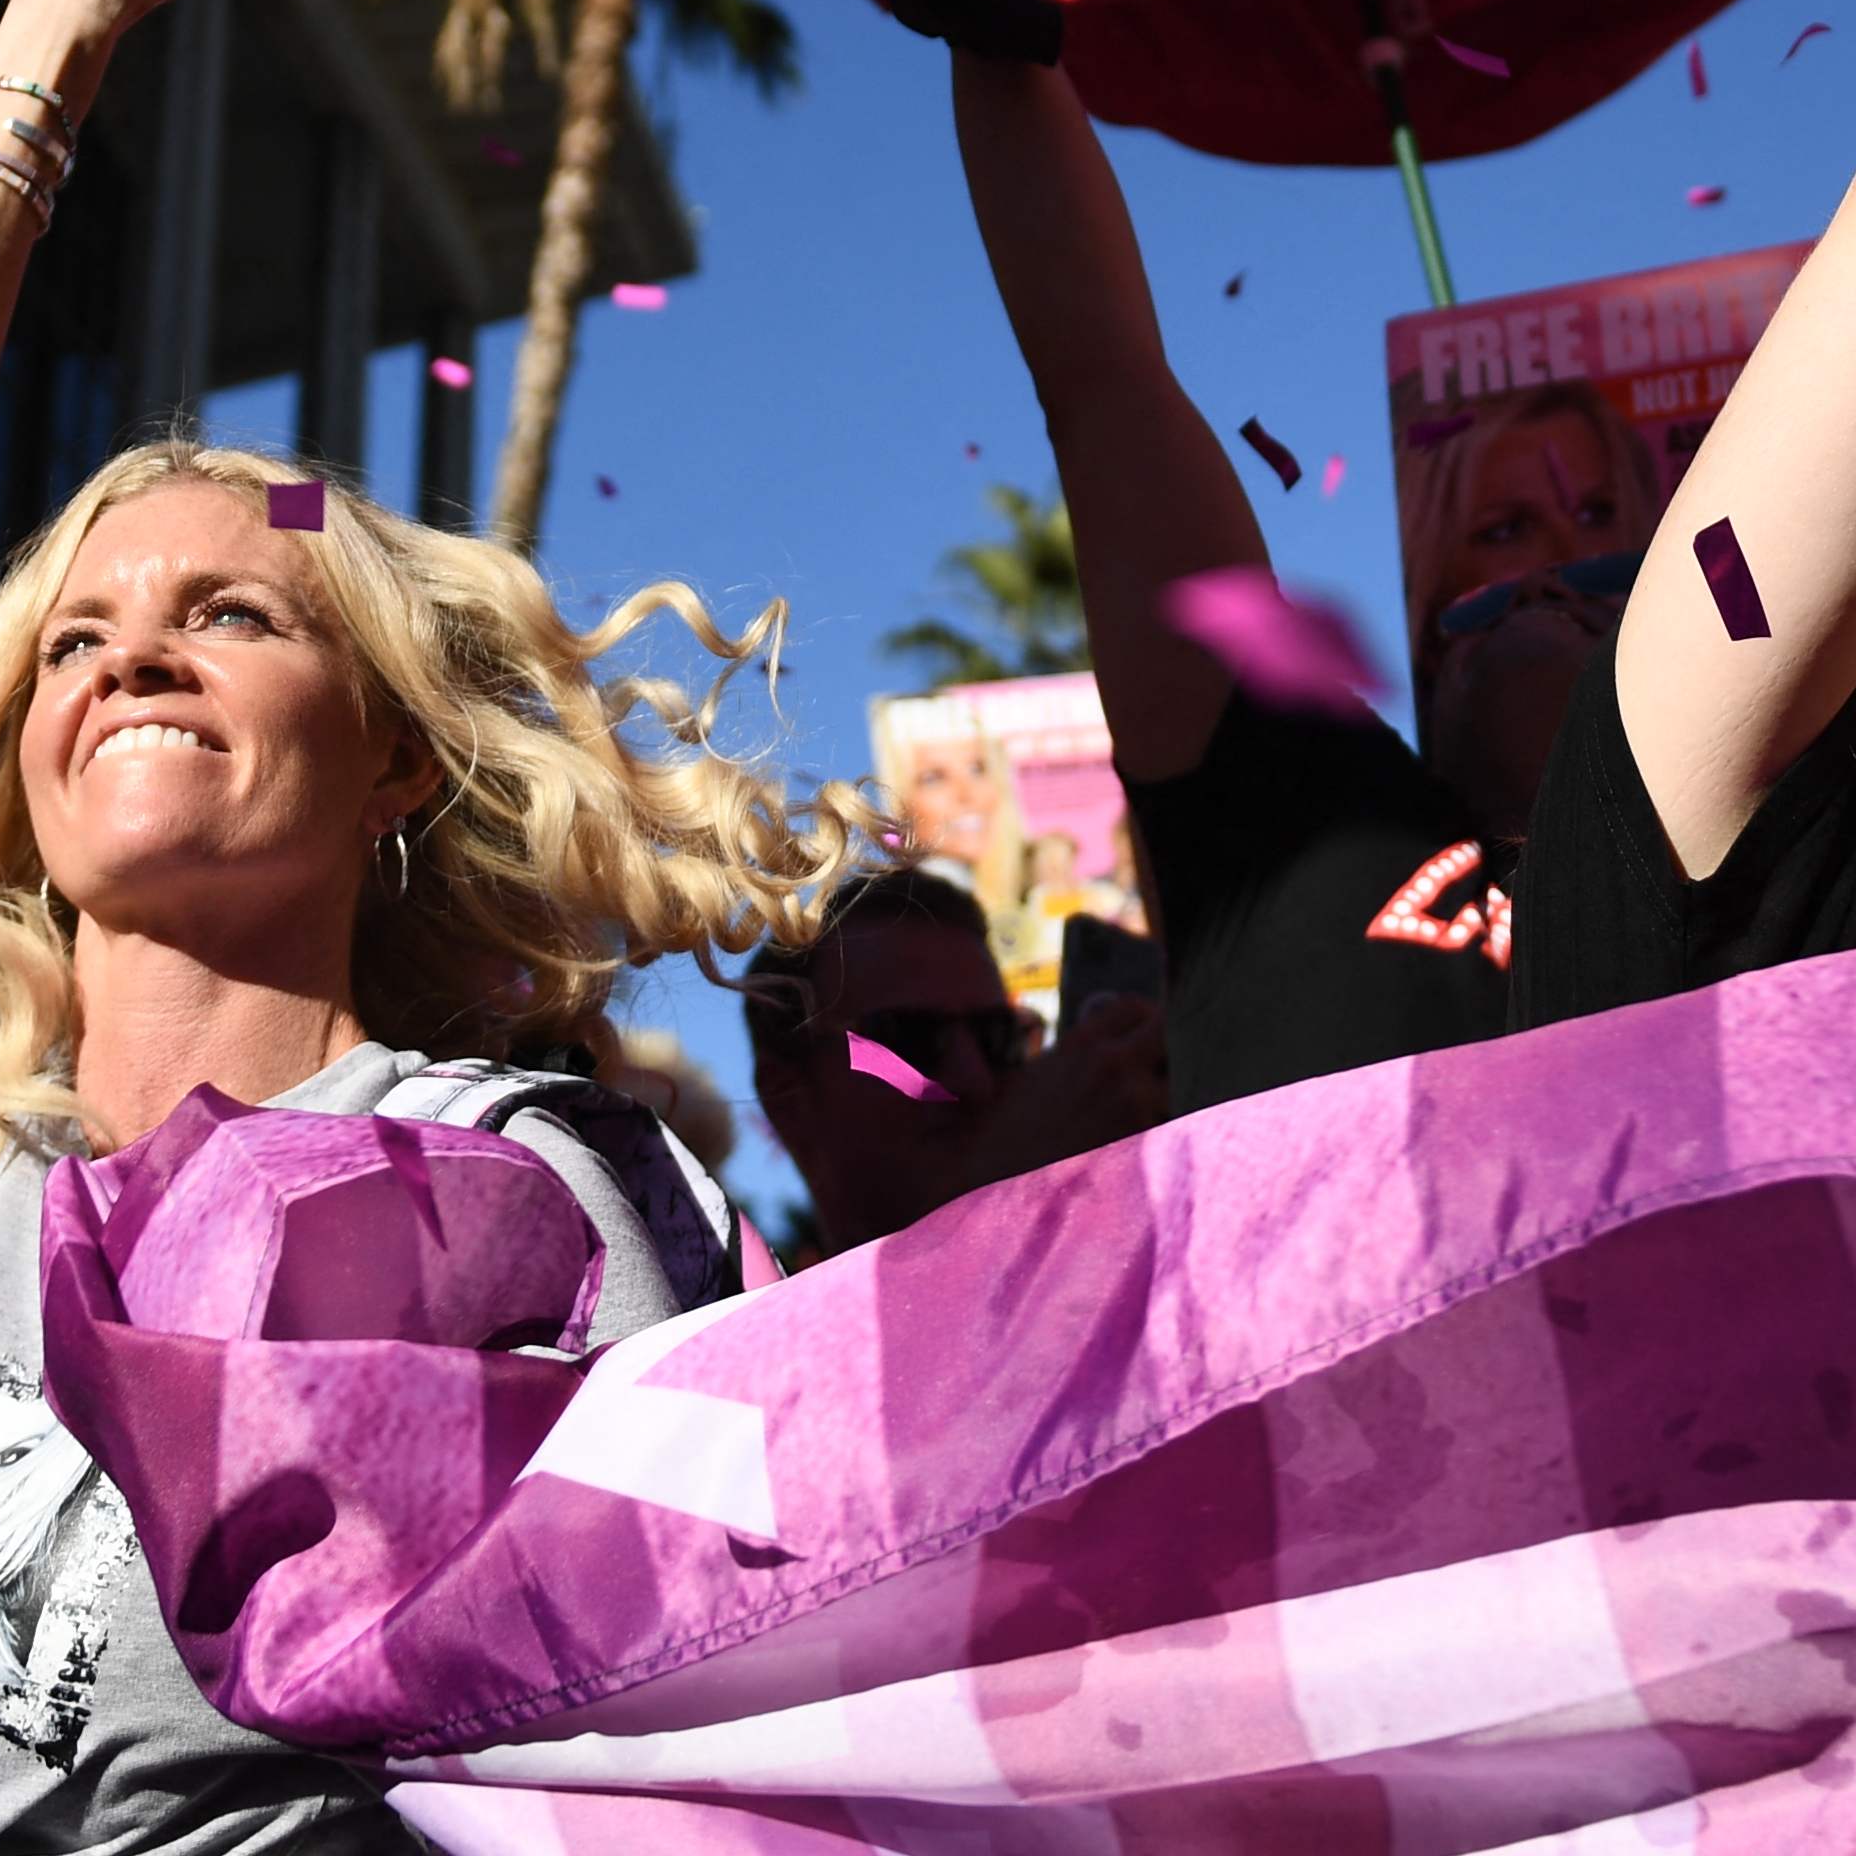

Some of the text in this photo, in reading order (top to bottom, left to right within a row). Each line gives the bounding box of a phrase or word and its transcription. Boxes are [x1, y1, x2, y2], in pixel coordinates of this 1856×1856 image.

[1419, 264, 1792, 406] FREE BRIT
[1631, 367, 1703, 416] NOT
